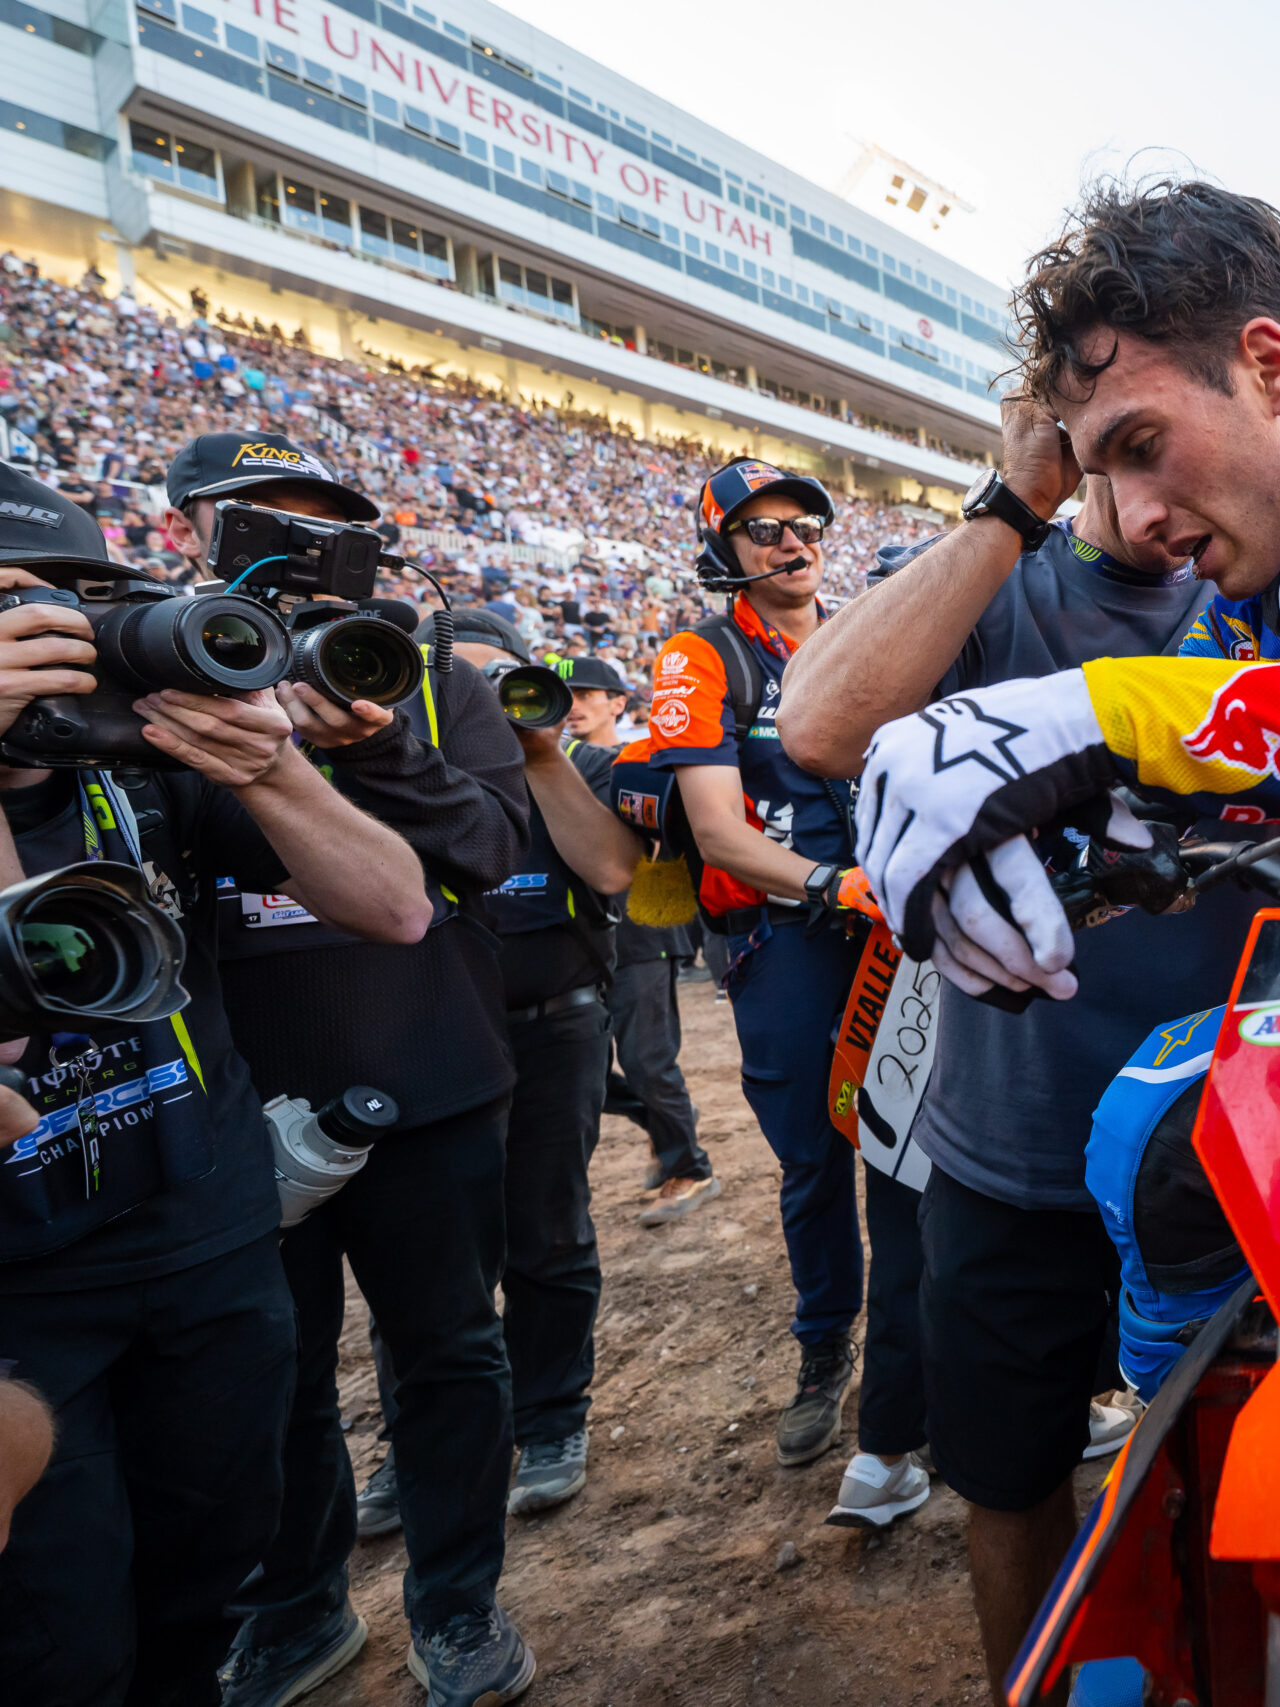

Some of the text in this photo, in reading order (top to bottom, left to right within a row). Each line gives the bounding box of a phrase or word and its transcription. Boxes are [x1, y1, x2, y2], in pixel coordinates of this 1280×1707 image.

[323, 15, 604, 175] UNIVERSITY
[620, 163, 669, 204] OF
[683, 191, 771, 256] UTAH
[846, 941, 899, 1052] VIALLE
